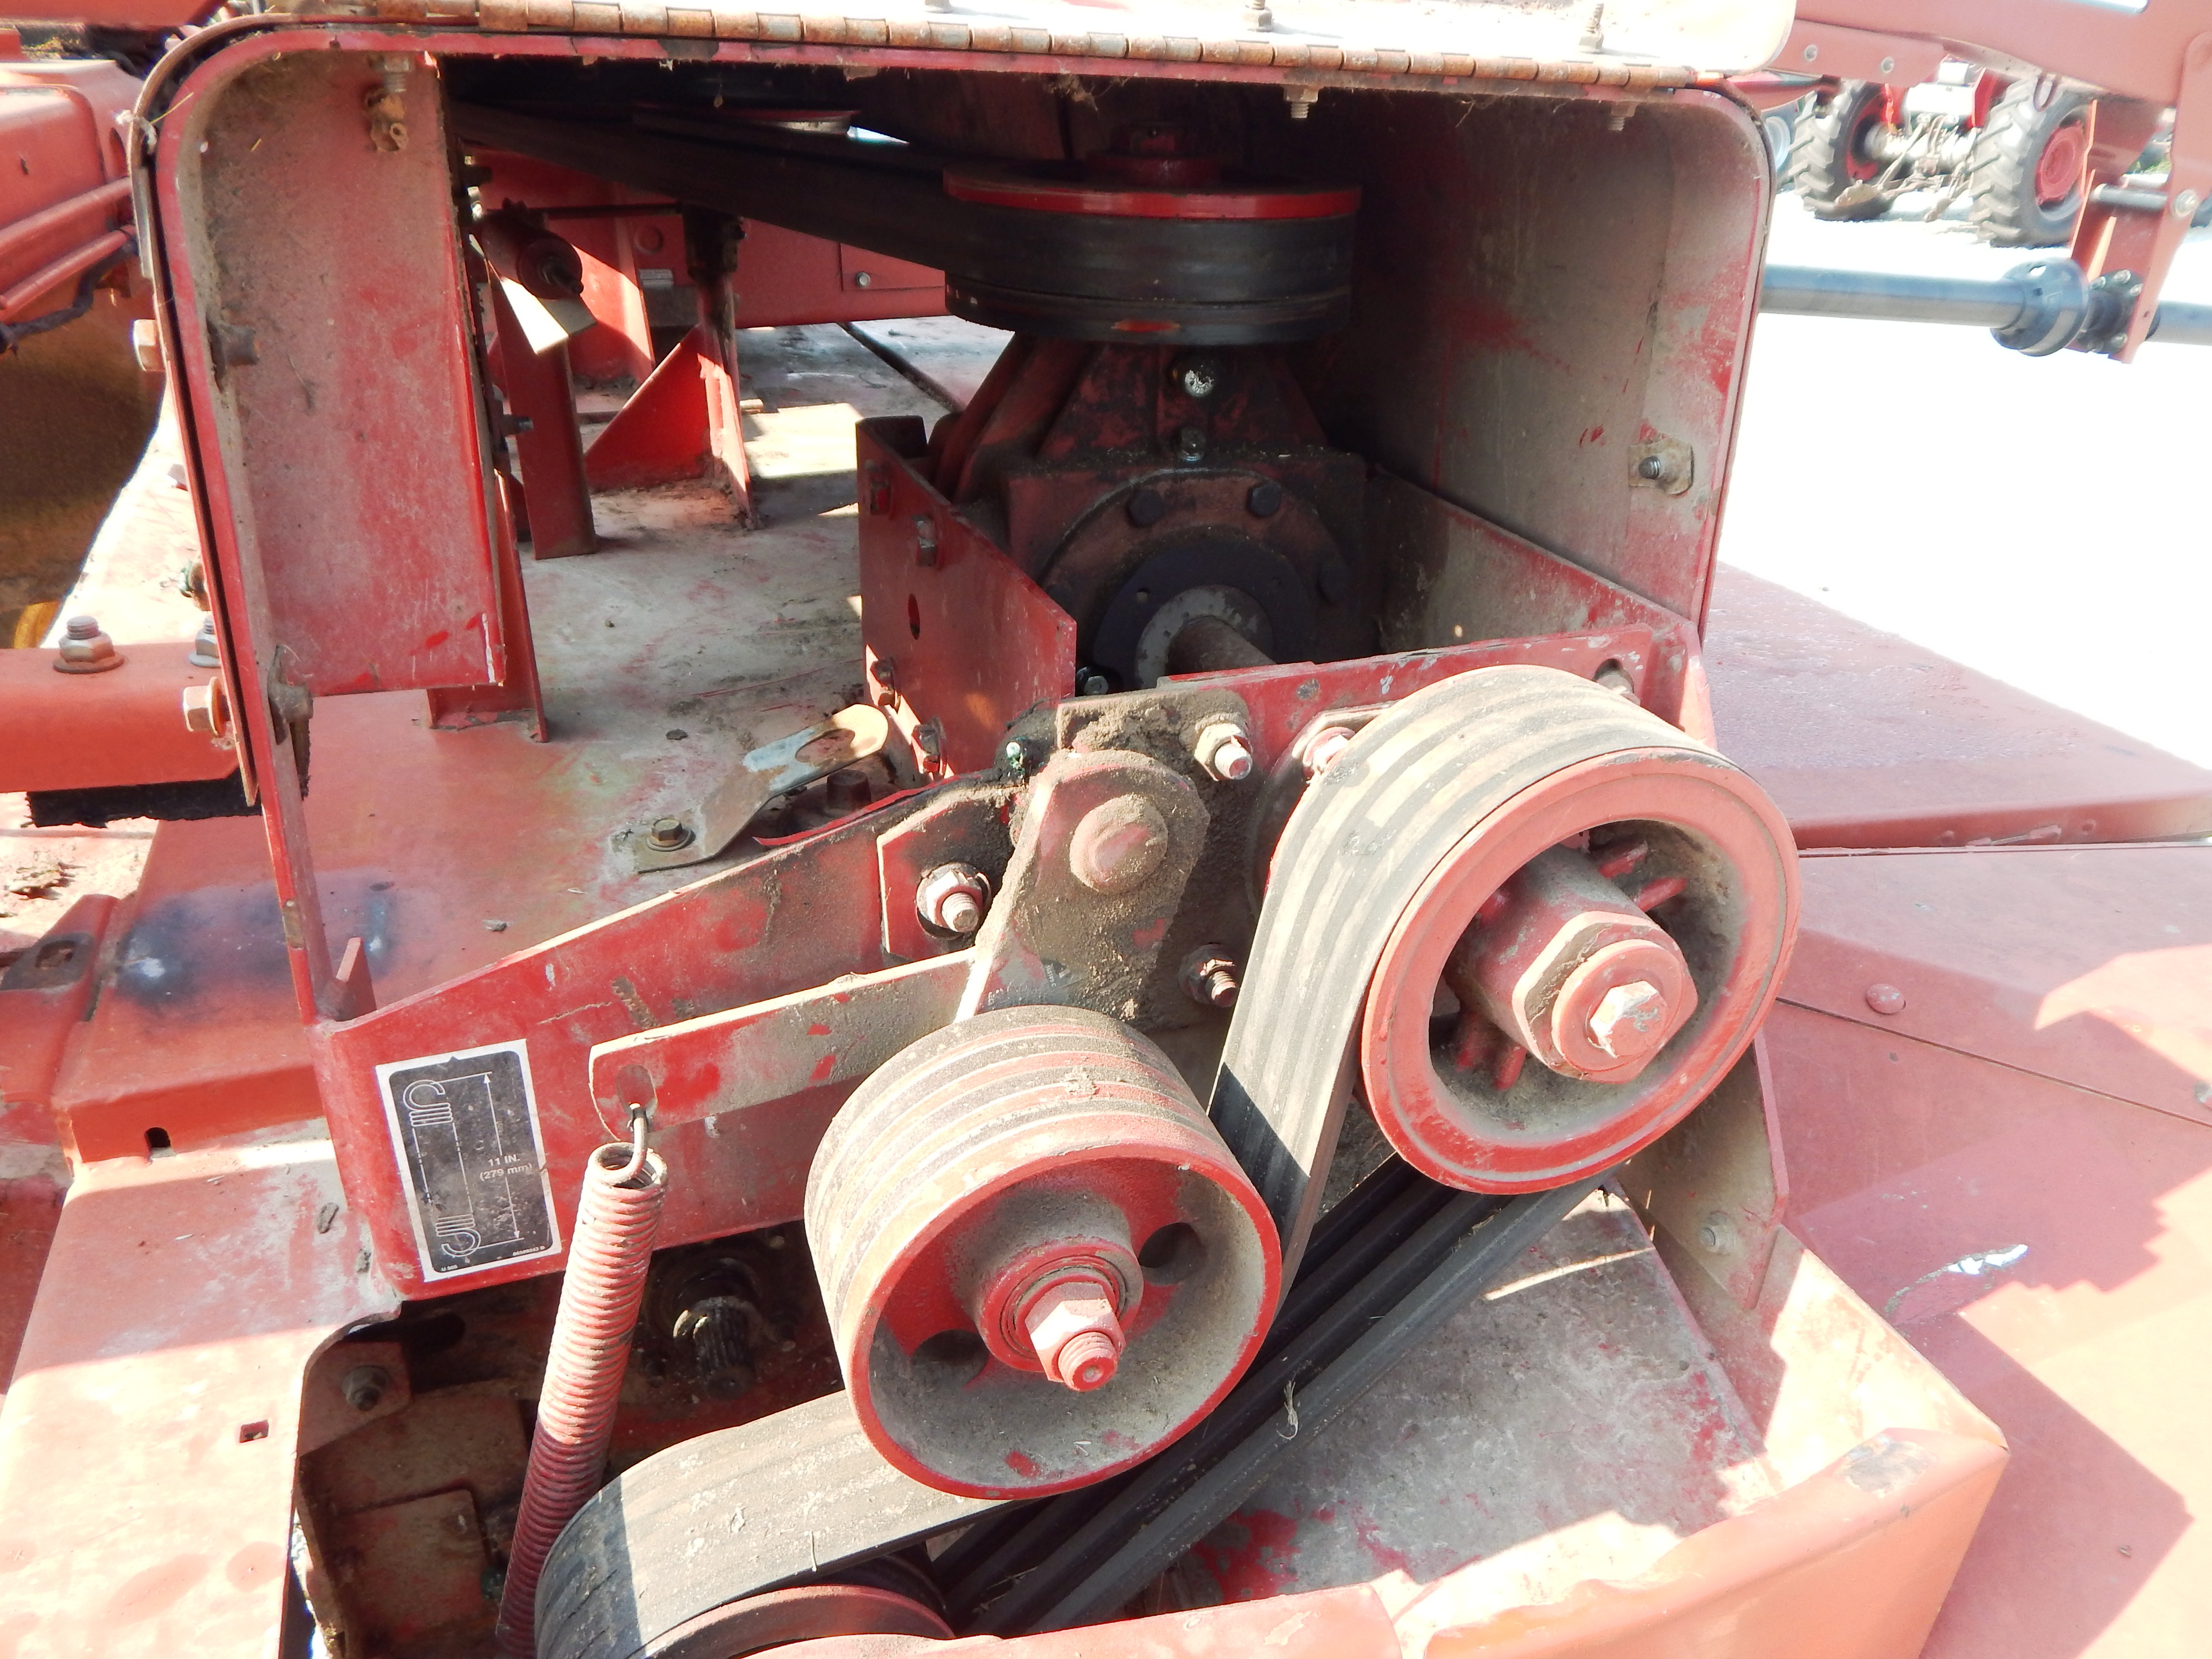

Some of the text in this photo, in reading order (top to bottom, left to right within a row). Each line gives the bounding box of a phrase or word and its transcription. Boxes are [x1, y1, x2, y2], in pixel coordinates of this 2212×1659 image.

[488, 1154, 520, 1166] 11 IN.
[480, 1163, 532, 1181] (279 mm)
